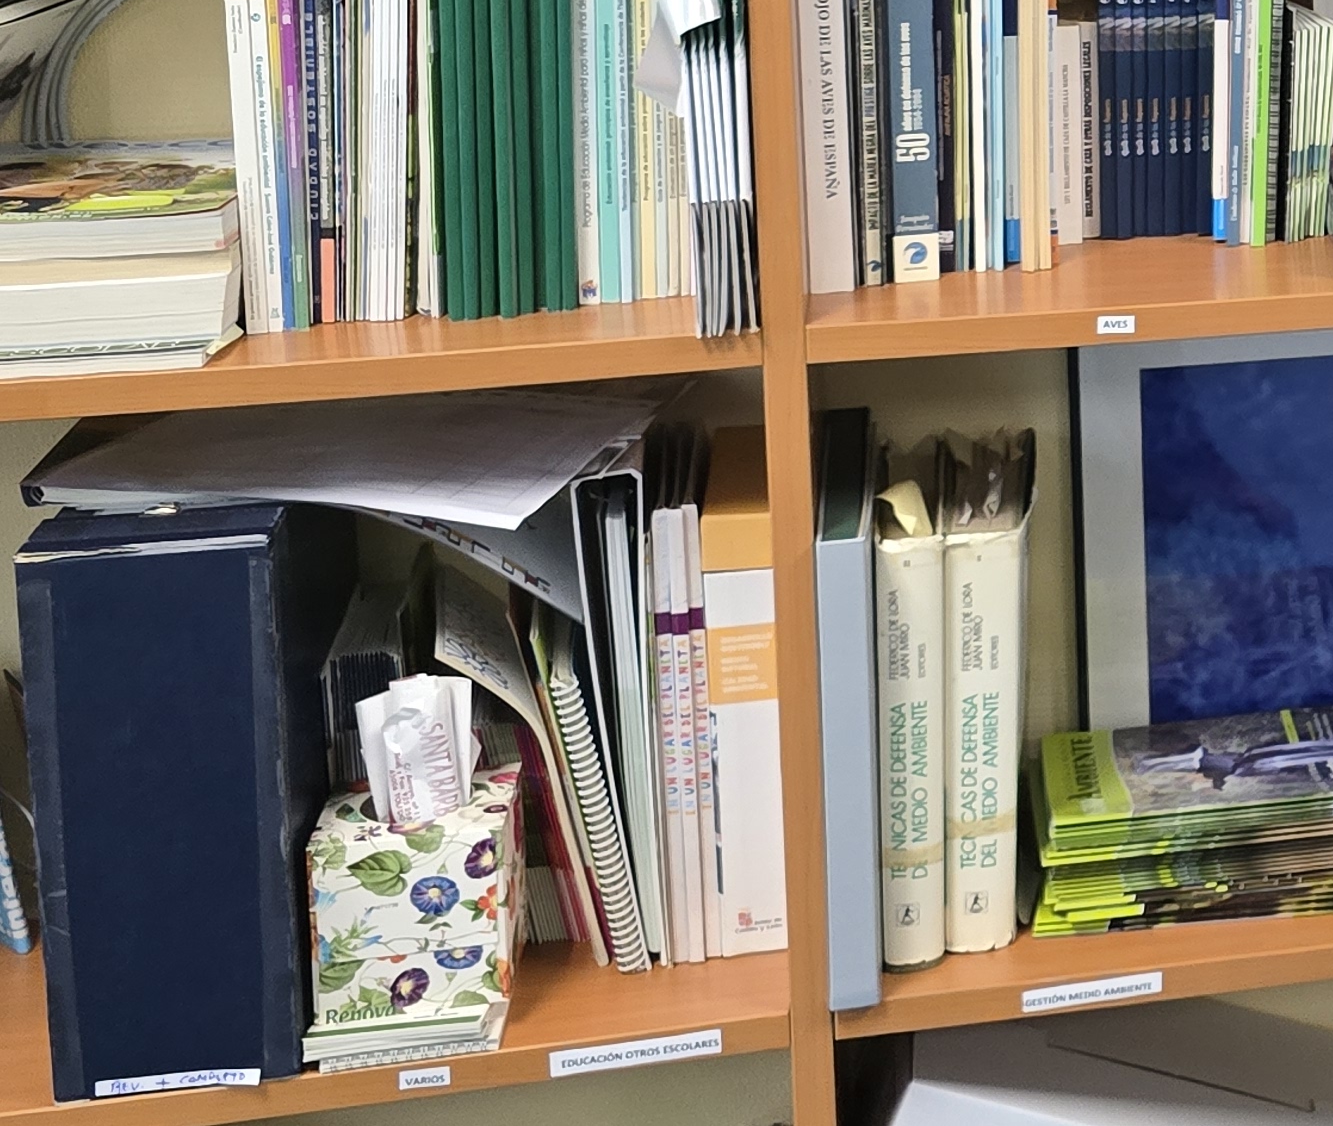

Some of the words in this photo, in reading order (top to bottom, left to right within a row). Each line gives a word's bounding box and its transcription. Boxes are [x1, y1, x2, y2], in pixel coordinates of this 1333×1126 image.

[818, 24, 833, 46] DE
[305, 14, 317, 133] SOSTENIBLE
[819, 49, 834, 76] LAS
[820, 79, 836, 116] AVES
[823, 118, 837, 140] DE
[308, 147, 319, 221] CIUDAD
[823, 143, 842, 199] ESPAÑA
[1103, 320, 1128, 329] AVES
[888, 702, 907, 774] DEFENSA
[911, 700, 929, 779] AMBIENTE
[961, 694, 980, 764] DEFENSA
[419, 722, 455, 778] SANTA
[888, 776, 907, 798] DE
[961, 766, 979, 788] DE
[911, 787, 929, 843] MEDIO
[1025, 993, 1067, 1007] GESTIÓN
[1068, 990, 1102, 1001] MEDIO
[1103, 981, 1152, 996] AMBIENTE
[325, 1005, 394, 1025] Renova
[561, 1052, 623, 1069] EDUCACIÓN
[624, 1046, 661, 1060] OTROS
[662, 1038, 720, 1054] ESCOLARES
[404, 1075, 446, 1086] VARIOS
